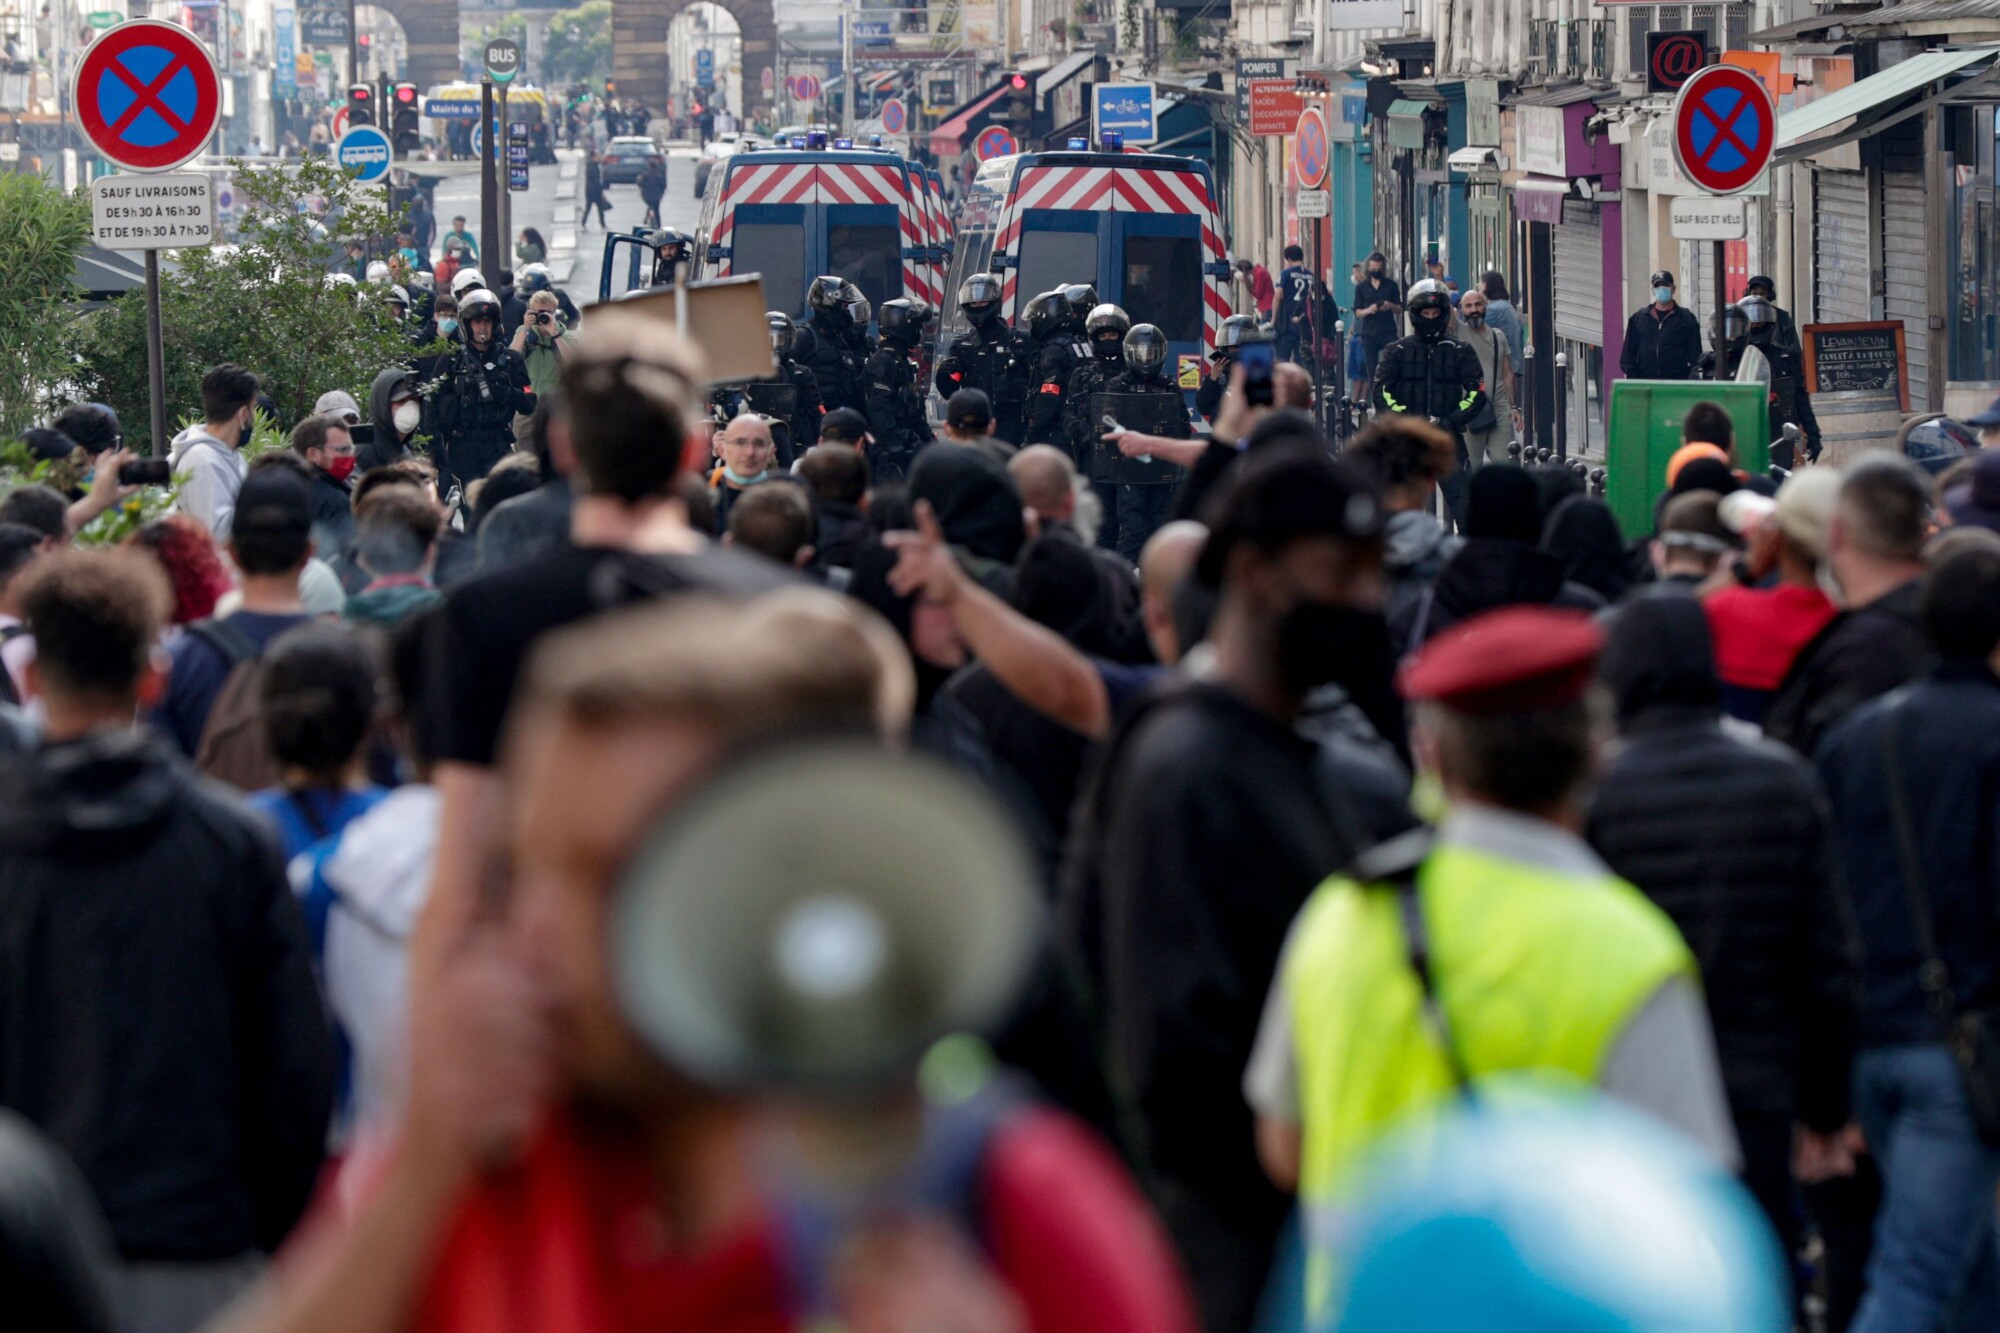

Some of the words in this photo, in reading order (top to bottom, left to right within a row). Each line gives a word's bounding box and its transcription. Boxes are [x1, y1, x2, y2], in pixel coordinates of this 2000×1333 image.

[489, 48, 516, 63] BUS
[1242, 62, 1277, 74] POMPES
[1255, 85, 1293, 93] ALTERMUN
[1255, 98, 1276, 106] MODE
[431, 104, 460, 113] Mairie
[461, 104, 473, 113] du
[1255, 109, 1300, 119] DÉCORATION
[512, 124, 526, 135] 38
[1255, 122, 1287, 131] ENFANTS
[100, 187, 132, 199] SAUF
[135, 185, 206, 198] LIVRAISONS
[106, 207, 121, 218] DE
[155, 204, 163, 217] À
[1673, 215, 1694, 224] SAUF
[1695, 215, 1709, 224] BUS
[1711, 215, 1720, 224] ET
[1722, 213, 1741, 224] VÉLO
[99, 227, 113, 238] ET
[115, 226, 129, 238] DE
[169, 223, 177, 236] À
